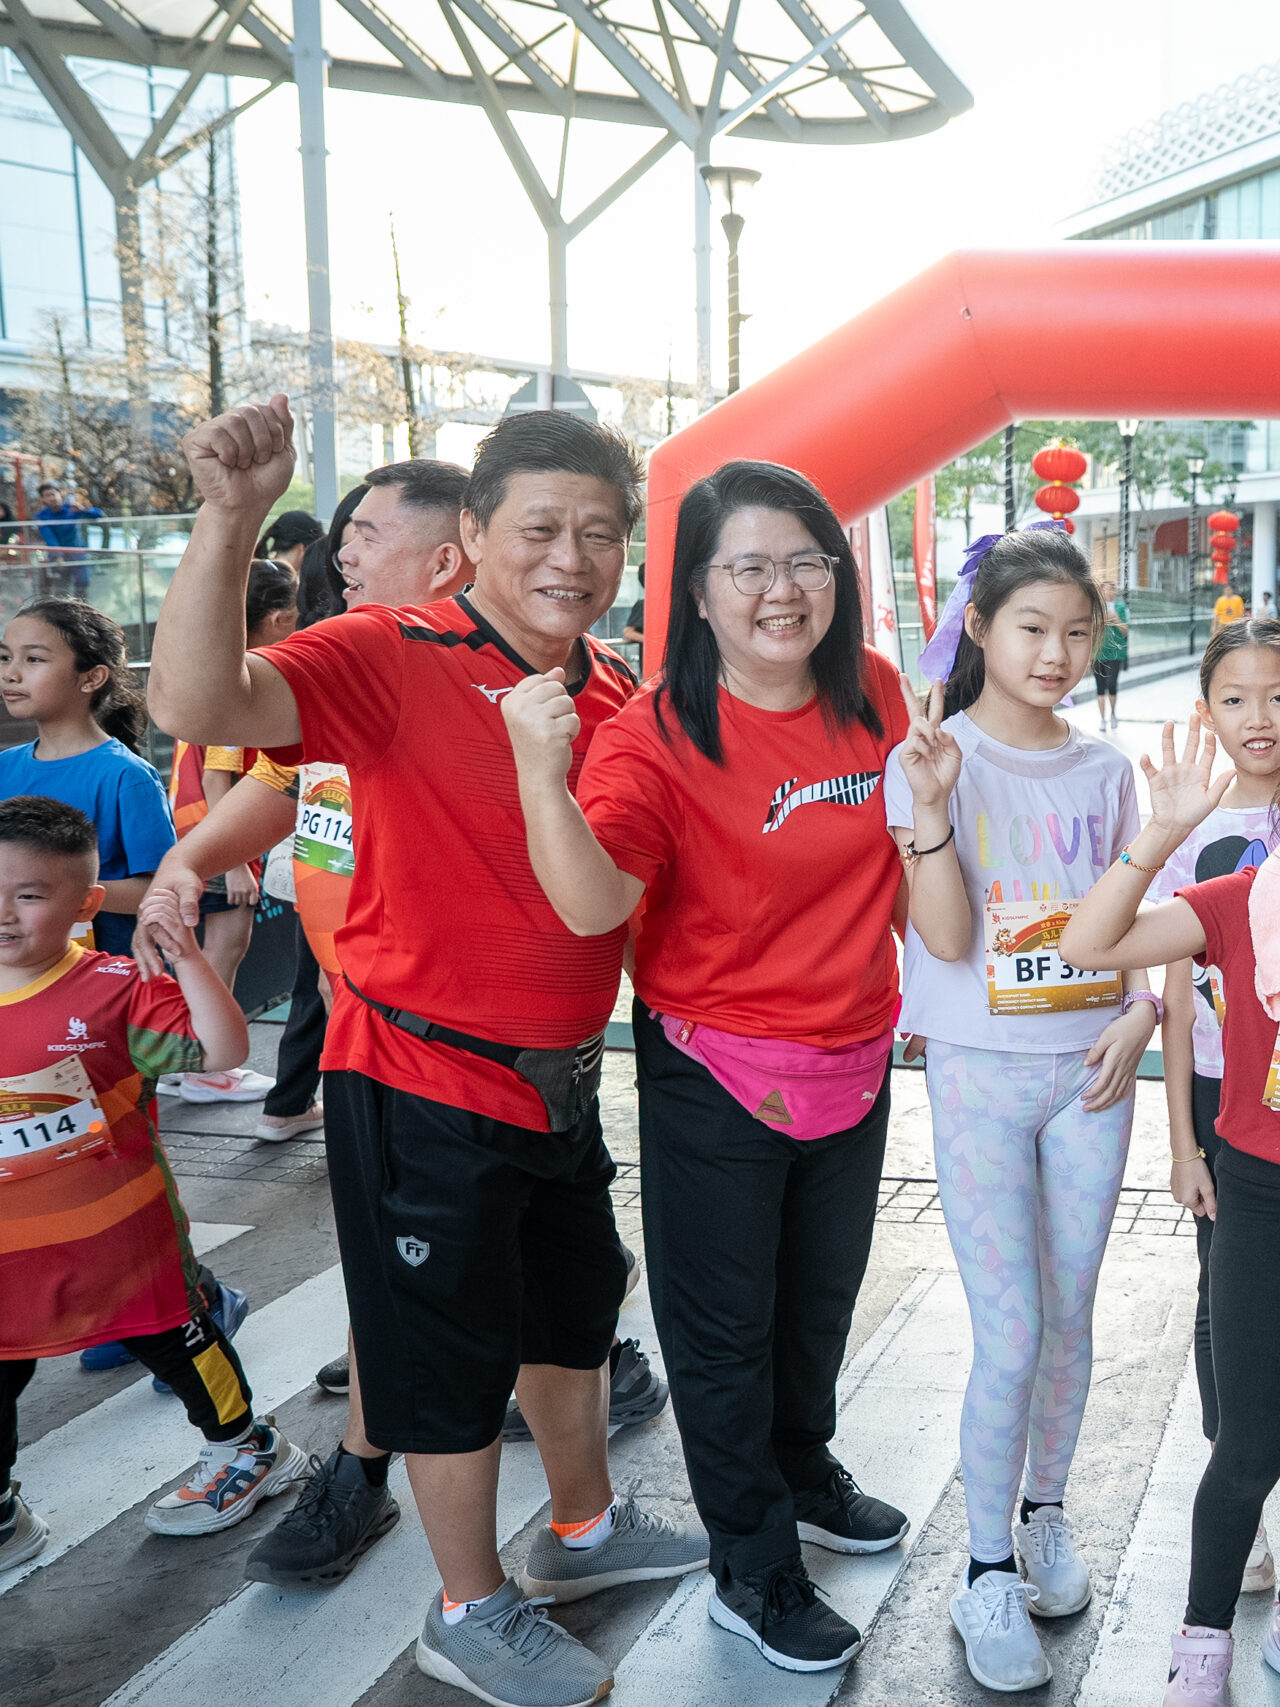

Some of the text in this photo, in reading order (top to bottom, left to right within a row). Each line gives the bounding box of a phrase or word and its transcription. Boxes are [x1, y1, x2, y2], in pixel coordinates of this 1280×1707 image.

[300, 809, 353, 846] PG 114
[977, 813, 1105, 868] LOVE
[1016, 956, 1051, 983] BF
[13, 1114, 77, 1148] 114
